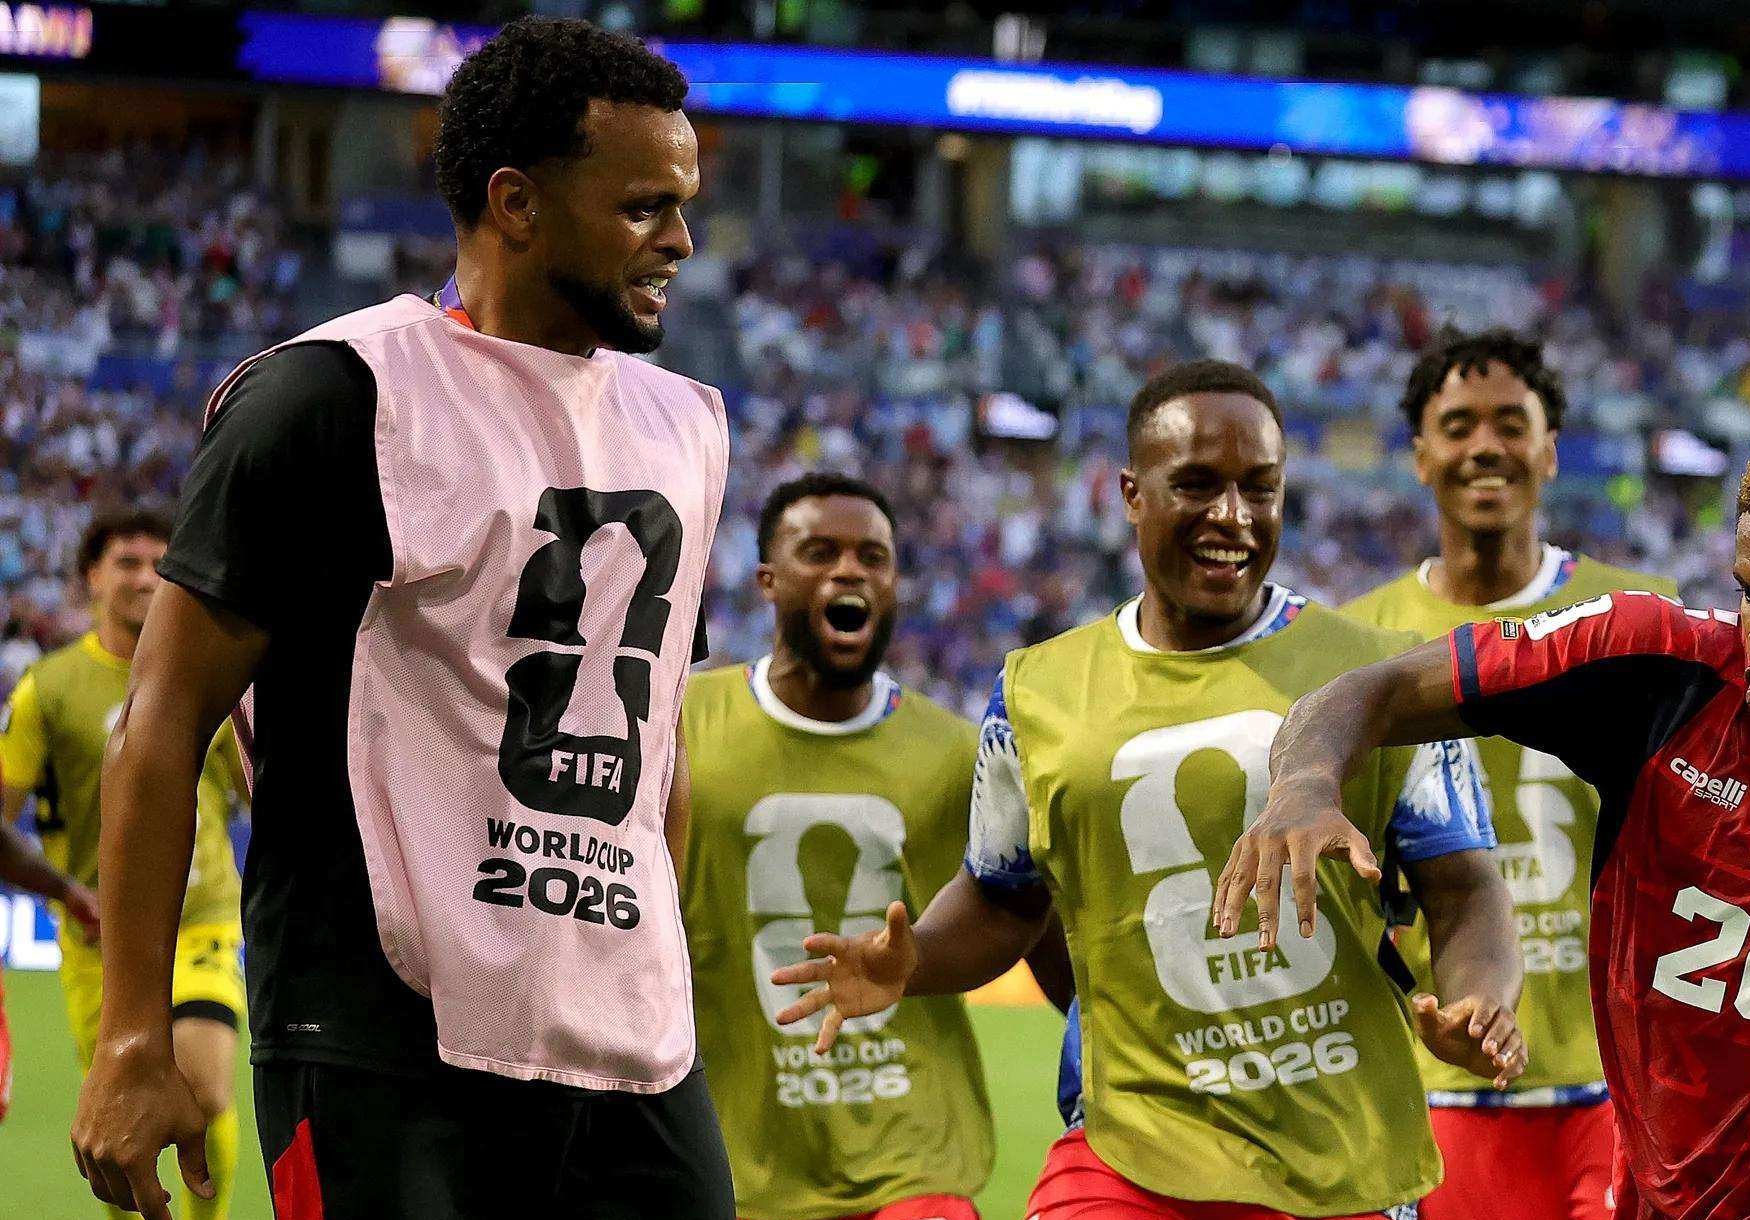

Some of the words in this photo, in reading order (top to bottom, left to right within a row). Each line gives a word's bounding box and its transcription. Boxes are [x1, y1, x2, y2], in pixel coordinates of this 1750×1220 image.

[549, 749, 622, 786] FIFA
[1670, 757, 1748, 806] capelli
[1694, 788, 1738, 812] SPORT
[486, 818, 600, 864] WORLD
[599, 839, 635, 876] CUP
[472, 858, 640, 931] 2026
[1206, 946, 1292, 985] FIFA
[1175, 1014, 1285, 1057] WORLD
[1290, 999, 1351, 1035] CUP
[1184, 1031, 1360, 1097] 2026
